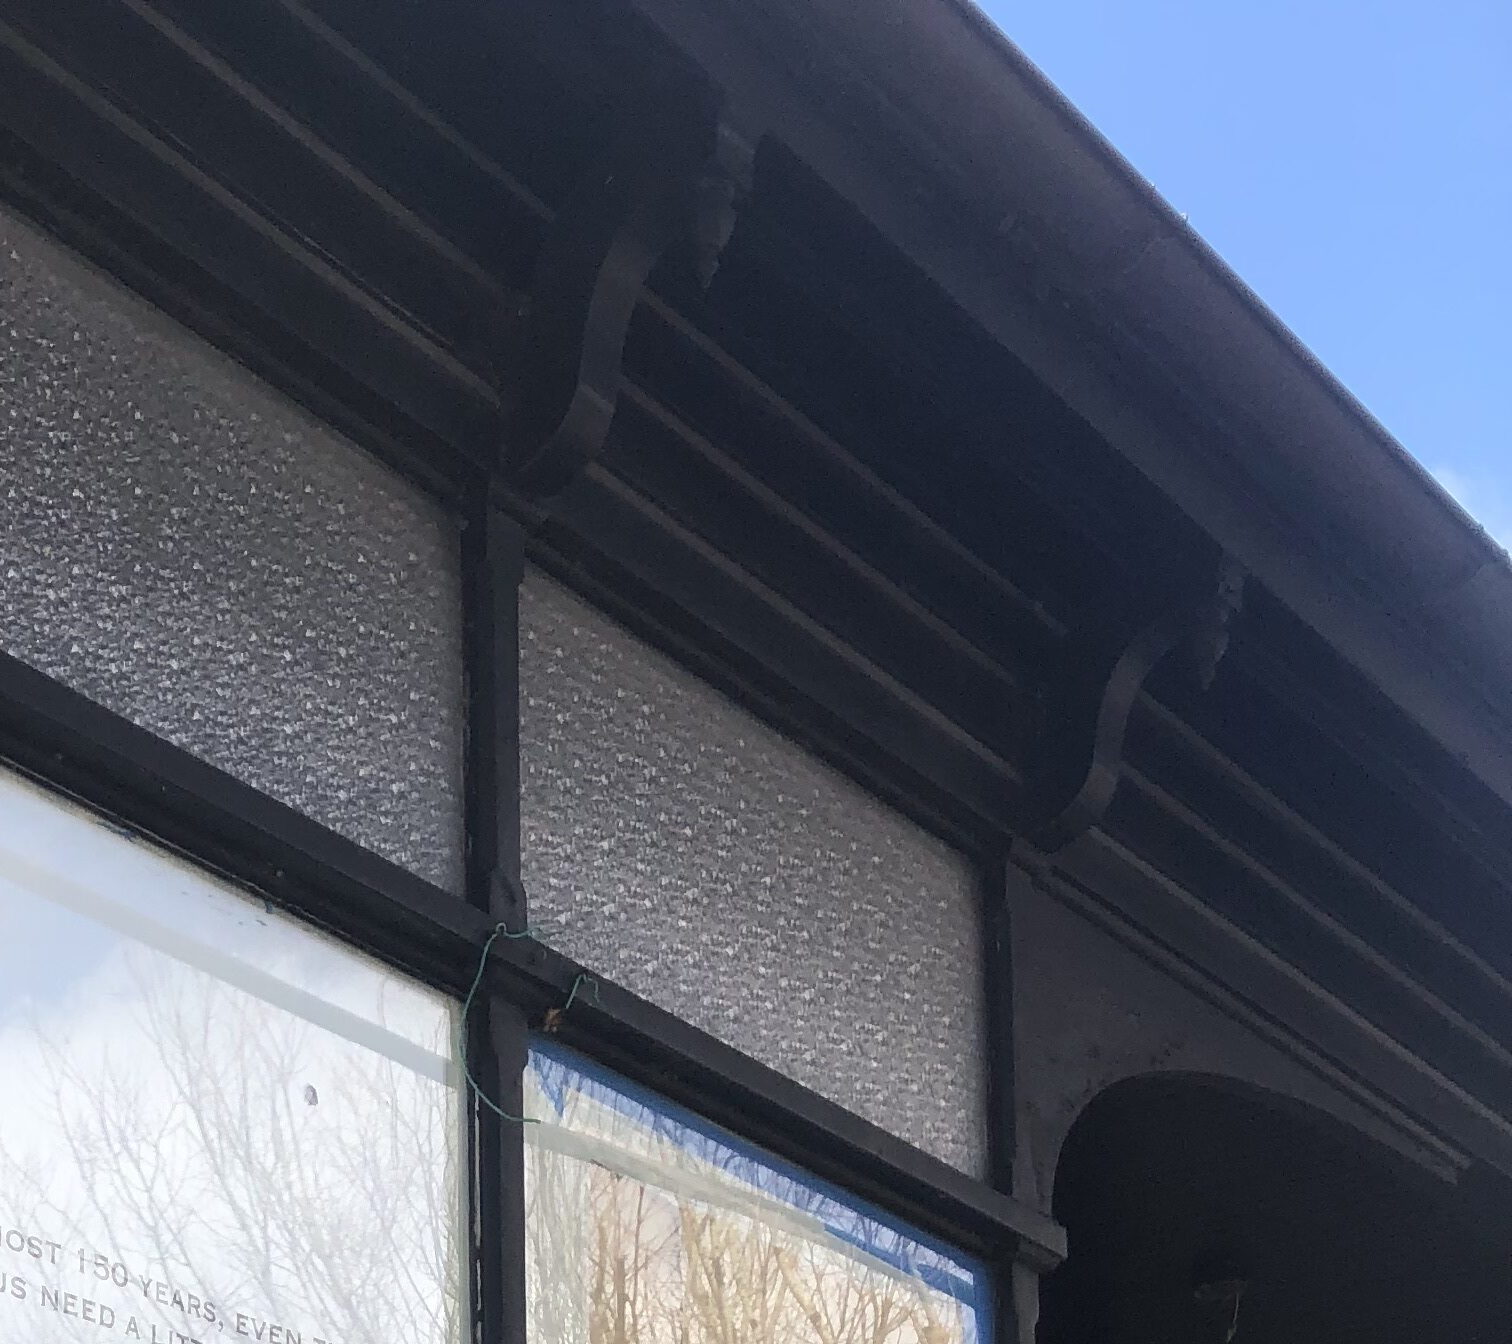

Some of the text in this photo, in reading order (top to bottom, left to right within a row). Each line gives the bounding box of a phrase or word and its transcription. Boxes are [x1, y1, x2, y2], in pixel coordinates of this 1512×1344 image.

[40, 1286, 115, 1330] NEED
[124, 1316, 140, 1340] A
[76, 1247, 129, 1289] 150
[139, 1274, 225, 1333] YEARS,
